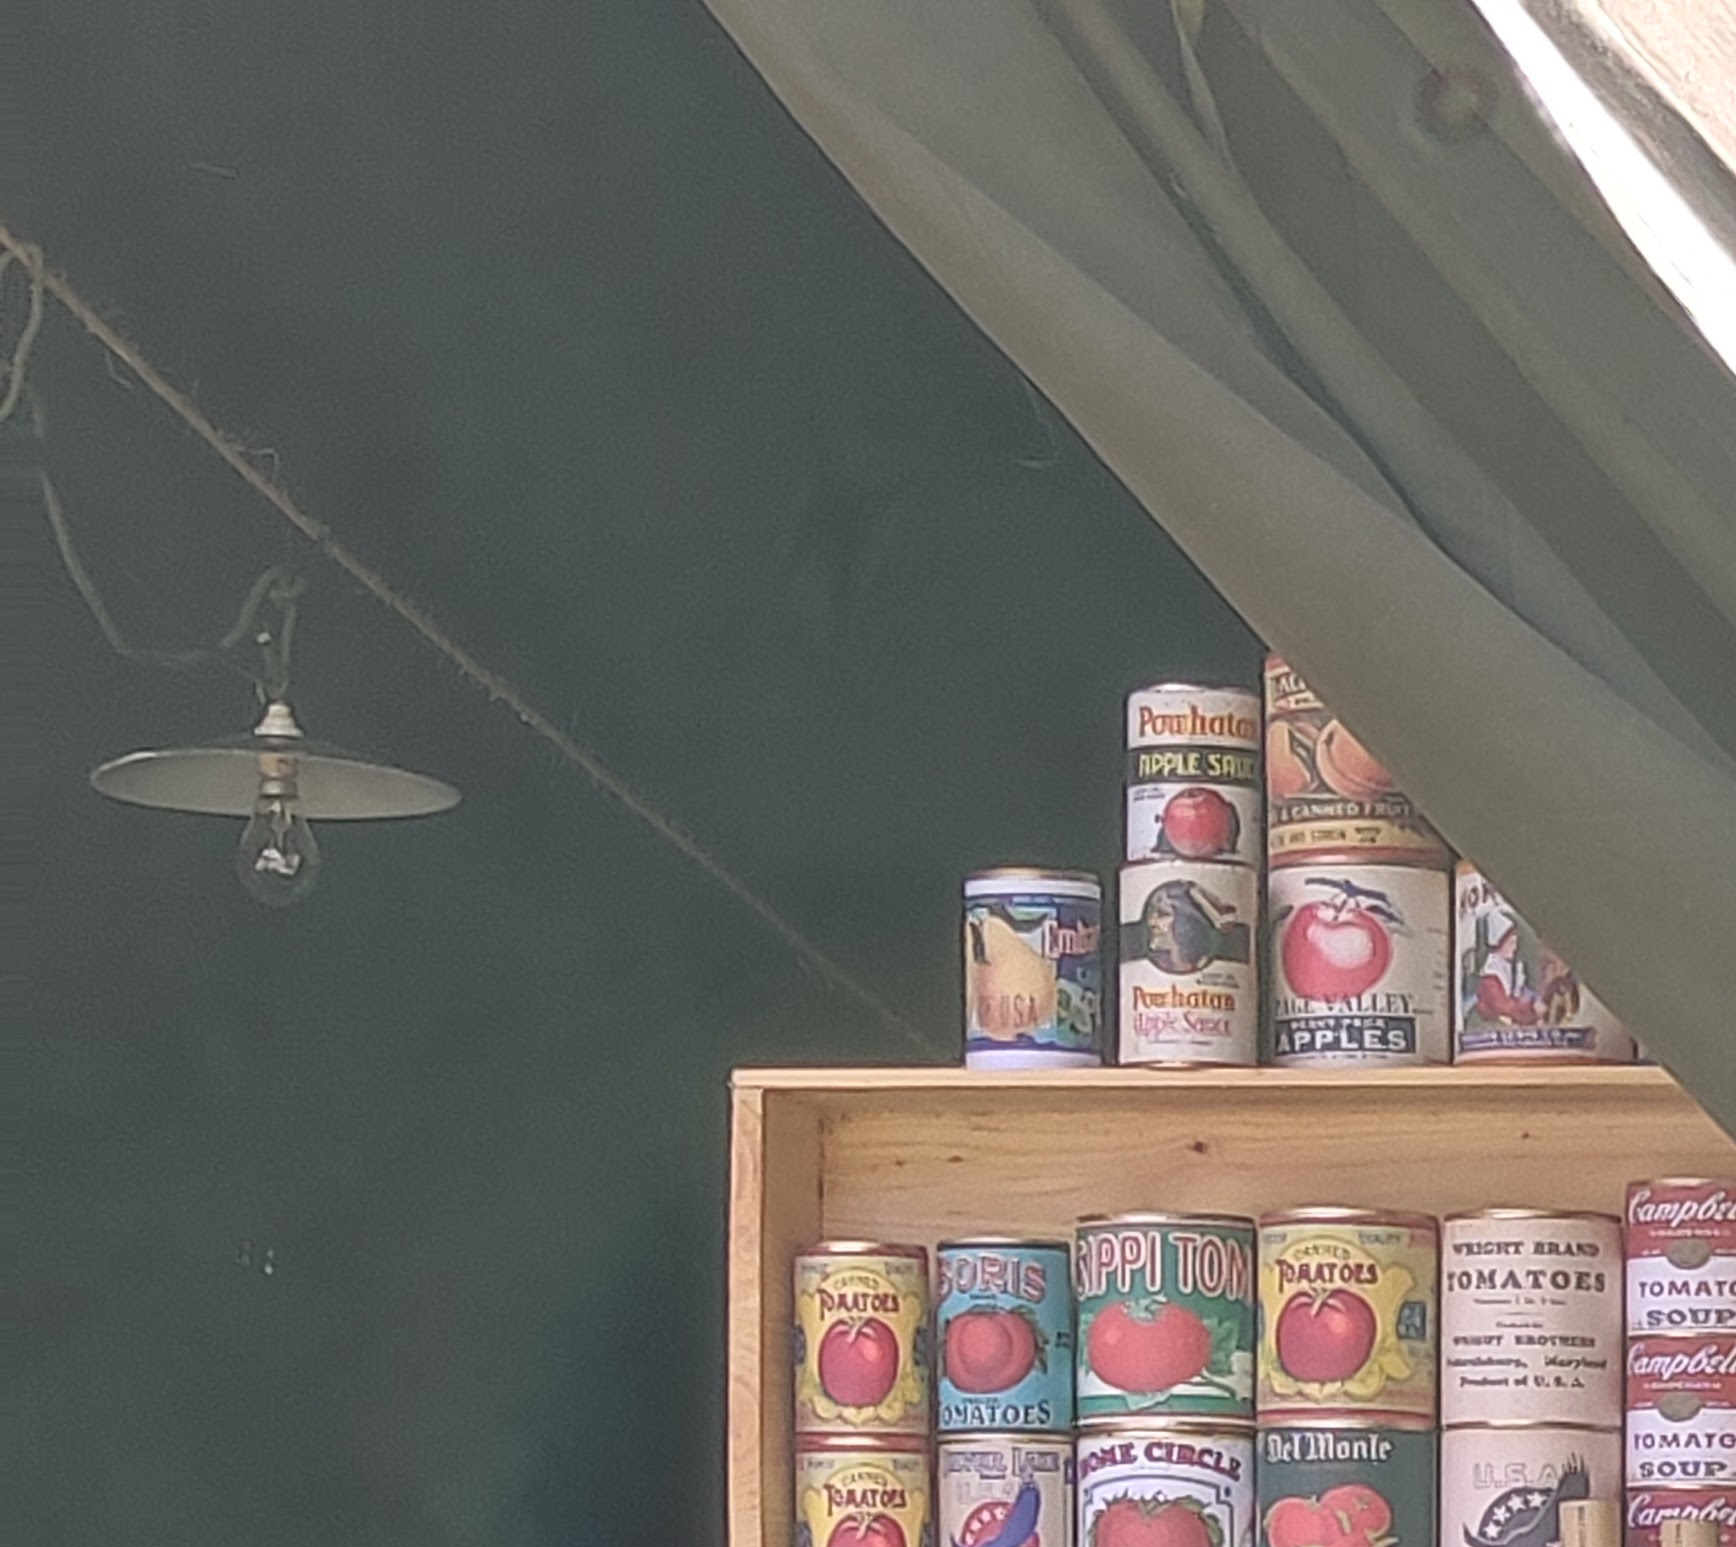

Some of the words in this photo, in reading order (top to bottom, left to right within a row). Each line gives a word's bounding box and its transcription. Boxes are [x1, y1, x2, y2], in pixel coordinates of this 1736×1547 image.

[1139, 753, 1200, 778] APPLE
[1208, 753, 1256, 778] SAUC
[1132, 985, 1236, 1012] Powhatan
[1326, 992, 1413, 1015] VALLEY
[1278, 1028, 1406, 1052] APPLES
[1452, 1241, 1524, 1257] WRIGHT
[1532, 1242, 1600, 1257] BRAND
[1274, 1259, 1379, 1293] TOMATOES
[1447, 1268, 1606, 1293] TOMATOES
[816, 1288, 900, 1321] TOMATOES
[941, 1399, 1050, 1426] OMATOES
[1144, 1441, 1241, 1482] CIRCLE
[1639, 1460, 1729, 1478] SOUP
[822, 1484, 908, 1513] TOMATOES
